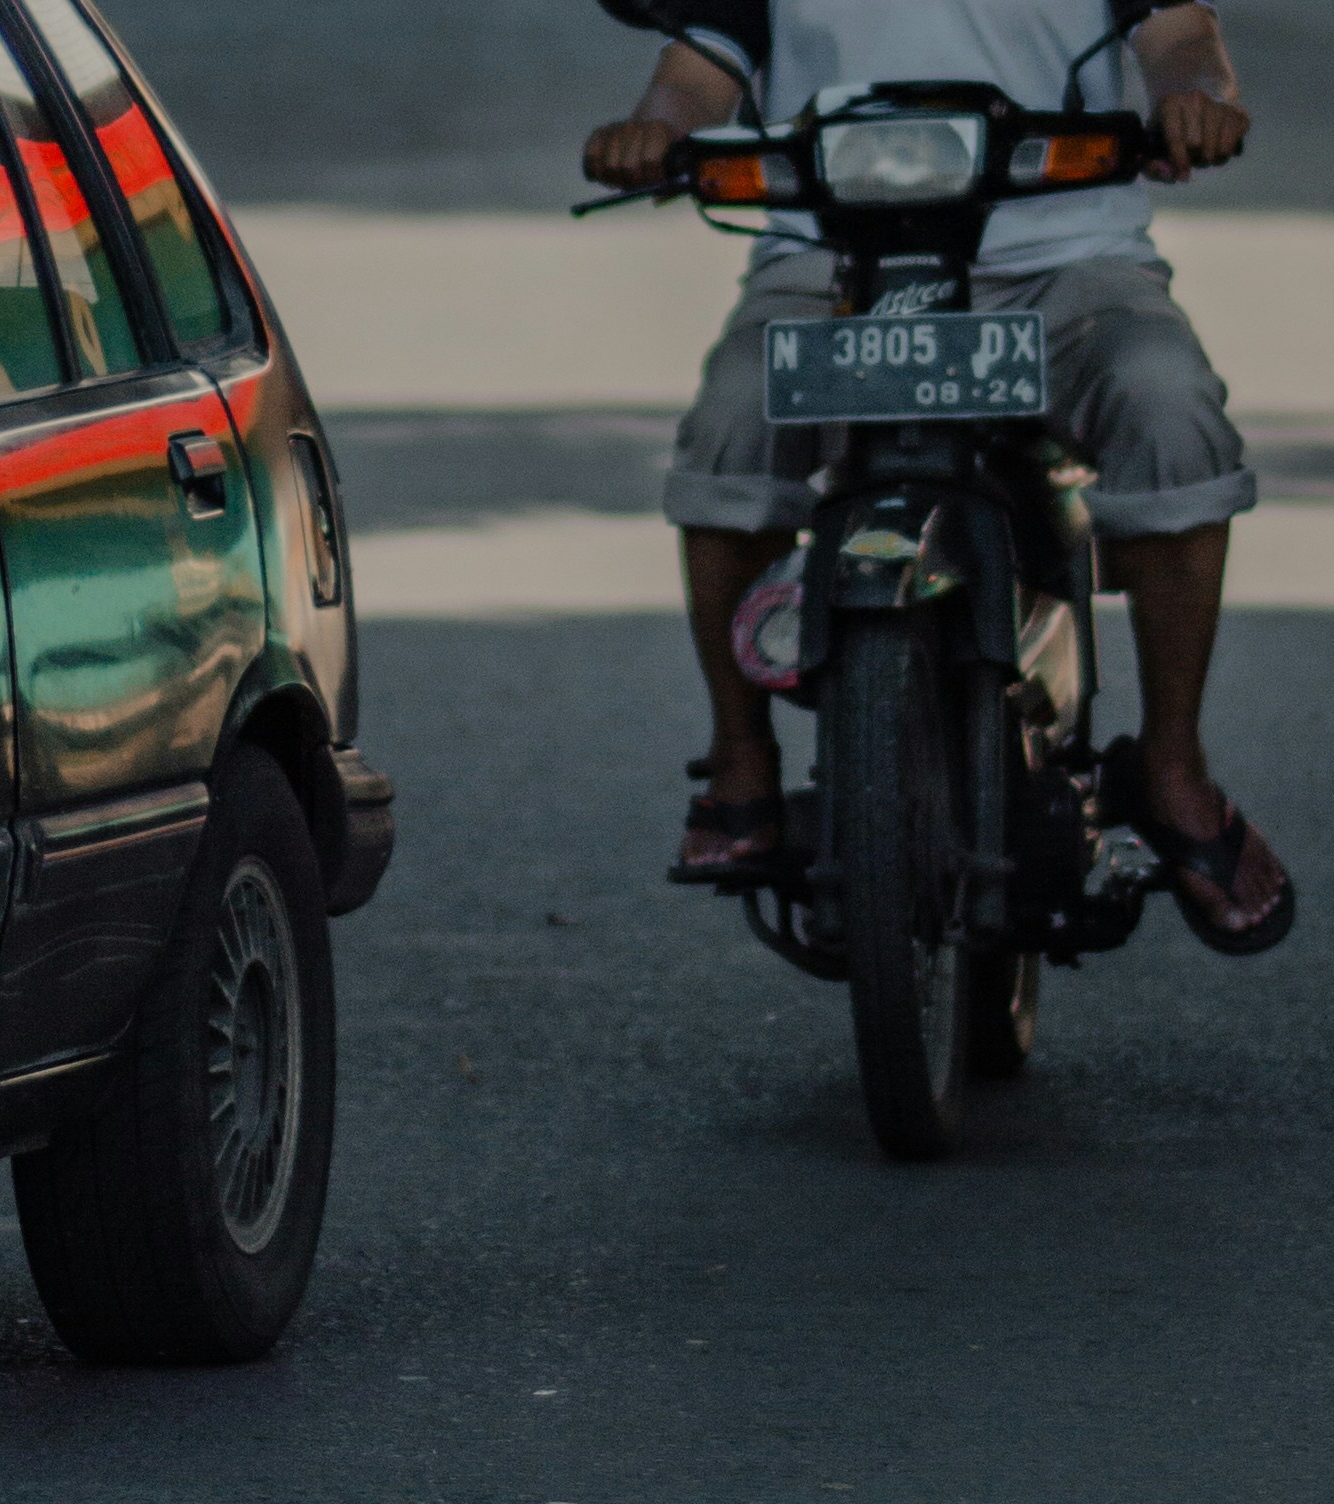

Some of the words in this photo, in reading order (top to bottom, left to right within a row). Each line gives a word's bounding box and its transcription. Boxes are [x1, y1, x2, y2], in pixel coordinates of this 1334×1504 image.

[773, 330, 798, 370] N
[832, 324, 938, 366] 3805
[973, 321, 1037, 370] DX
